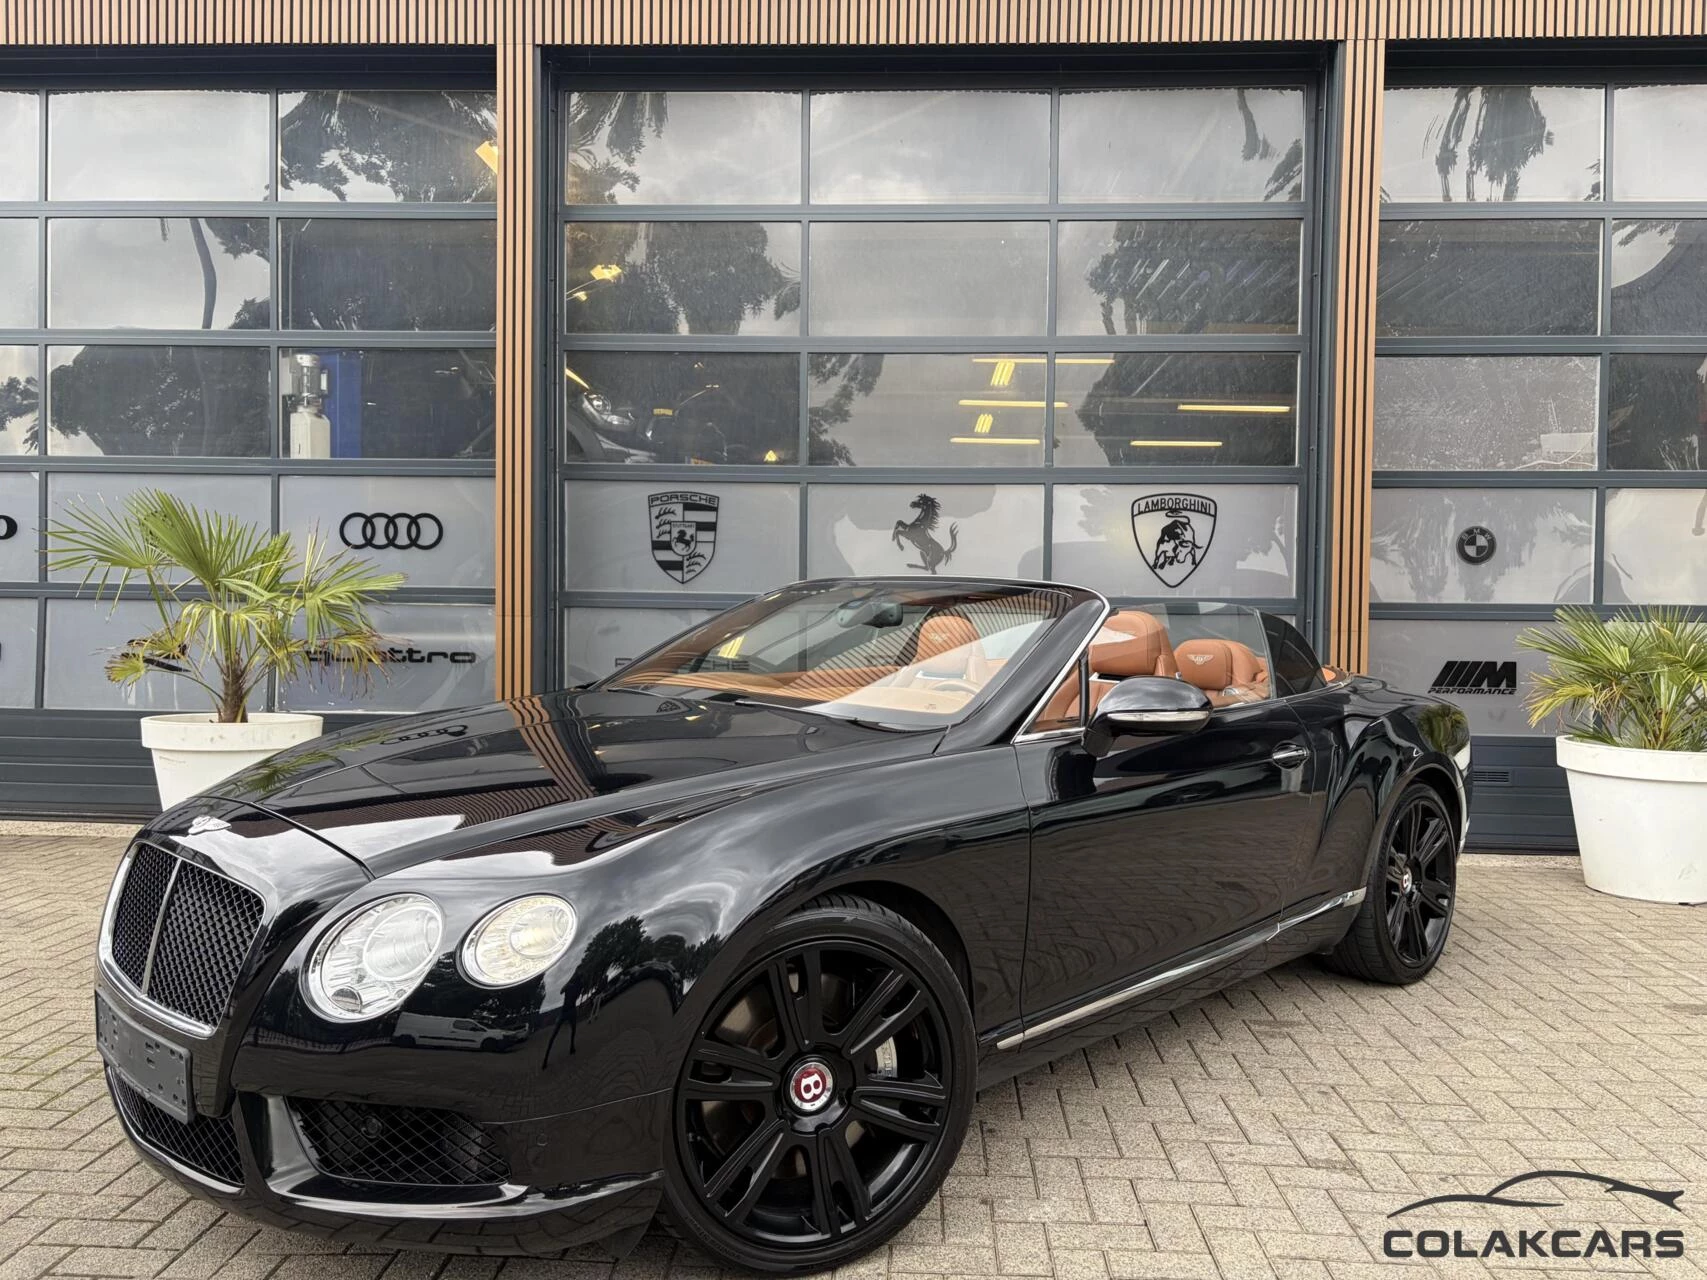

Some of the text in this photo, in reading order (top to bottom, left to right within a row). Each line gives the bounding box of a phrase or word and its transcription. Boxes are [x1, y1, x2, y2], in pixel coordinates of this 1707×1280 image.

[650, 494, 717, 506] PORSCHE
[1137, 498, 1211, 514] LAMBORGHINI
[1461, 528, 1493, 540] BMW
[307, 647, 476, 666] quttro
[1427, 687, 1517, 695] PERFORMANCE
